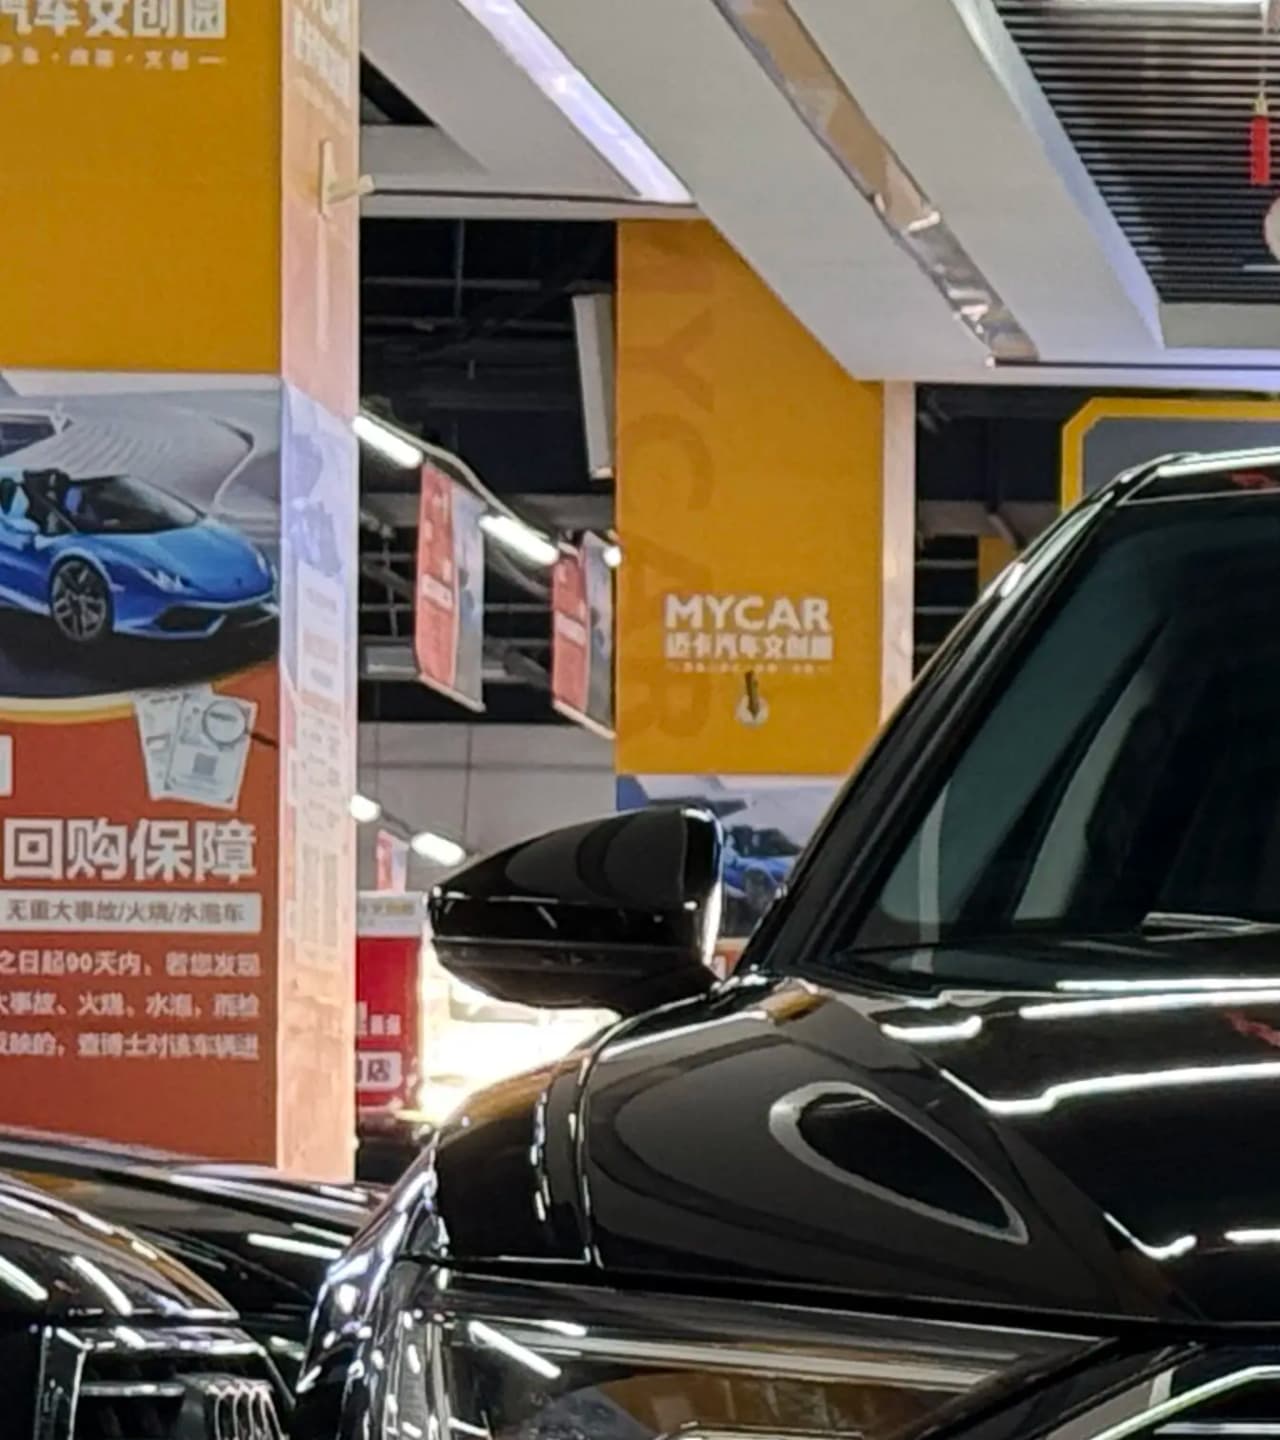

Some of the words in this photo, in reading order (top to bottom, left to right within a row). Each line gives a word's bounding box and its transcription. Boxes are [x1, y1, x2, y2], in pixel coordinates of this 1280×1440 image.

[665, 592, 833, 632] MYCAR
[3, 817, 257, 884] 回购保障
